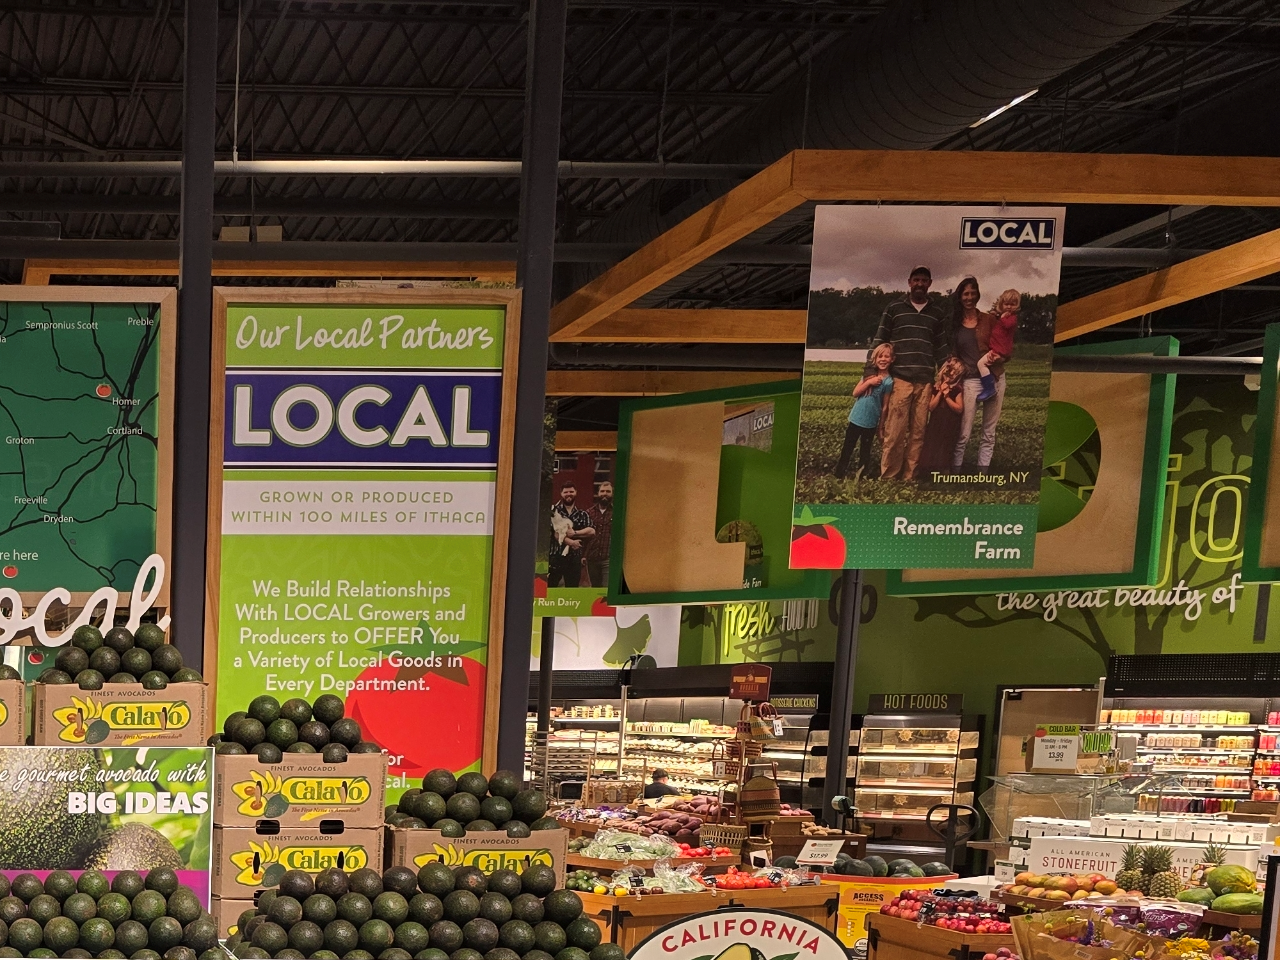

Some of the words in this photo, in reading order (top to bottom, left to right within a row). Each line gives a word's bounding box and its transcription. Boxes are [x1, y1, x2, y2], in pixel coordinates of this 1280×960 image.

[963, 221, 1052, 244] LOCAL
[25, 321, 75, 330] Sempronius
[77, 321, 98, 329] Scott
[128, 318, 153, 326] Preble
[236, 315, 290, 349] Our
[296, 315, 374, 350] Local
[379, 315, 493, 349] Partners
[112, 398, 140, 406] Homer
[233, 384, 490, 447] LOCAL
[107, 426, 142, 435] Cortland
[6, 436, 35, 445] Groton
[931, 471, 1006, 486] Trumansburg,
[1009, 472, 1028, 483] NY
[14, 496, 48, 504] Freeville
[260, 491, 324, 503] GROWN
[331, 492, 354, 503] OR
[361, 492, 454, 503] PRODUCED
[44, 515, 74, 524] Dryden
[231, 511, 292, 522] WITHIN
[299, 511, 332, 522] 100
[341, 511, 388, 523] MILES
[395, 511, 417, 523] OF
[424, 512, 485, 523] ITHACA
[893, 517, 1023, 535] Remembrance
[13, 550, 38, 560] here
[974, 541, 1020, 560] Farm
[253, 580, 280, 598] We
[286, 579, 330, 598] Build
[337, 579, 450, 603] Relationships
[1043, 589, 1110, 622] great
[1114, 579, 1206, 620] beauty
[1212, 573, 1244, 613] of
[558, 599, 581, 608] Dairy
[235, 603, 277, 621] With
[284, 604, 353, 621] LOCAL
[359, 604, 429, 621] Growers
[436, 604, 465, 621] and
[240, 628, 325, 645] Producers
[331, 630, 348, 645] to
[354, 627, 423, 645] OFFER
[428, 627, 459, 645] You
[724, 602, 774, 656] fresh
[234, 655, 242, 667] a
[248, 651, 310, 674] Variety
[315, 651, 334, 668] of
[338, 651, 382, 668] Local
[388, 651, 442, 668] Goods
[447, 652, 463, 668] in
[266, 675, 315, 697] Every
[320, 674, 430, 697] Department.
[794, 698, 815, 707] CHICKENS
[884, 695, 904, 709] HOT
[910, 695, 948, 709] FOODS
[17, 763, 88, 791] gourmet
[96, 761, 159, 783] avocado
[167, 761, 206, 783] with
[69, 792, 116, 814] BIG
[125, 792, 209, 815] IDEAS
[1069, 850, 1110, 858] AMERICAN
[1043, 857, 1117, 872] STONEFRUIT
[853, 893, 884, 901] ACCESS
[662, 919, 819, 954] CALIFORNIA
